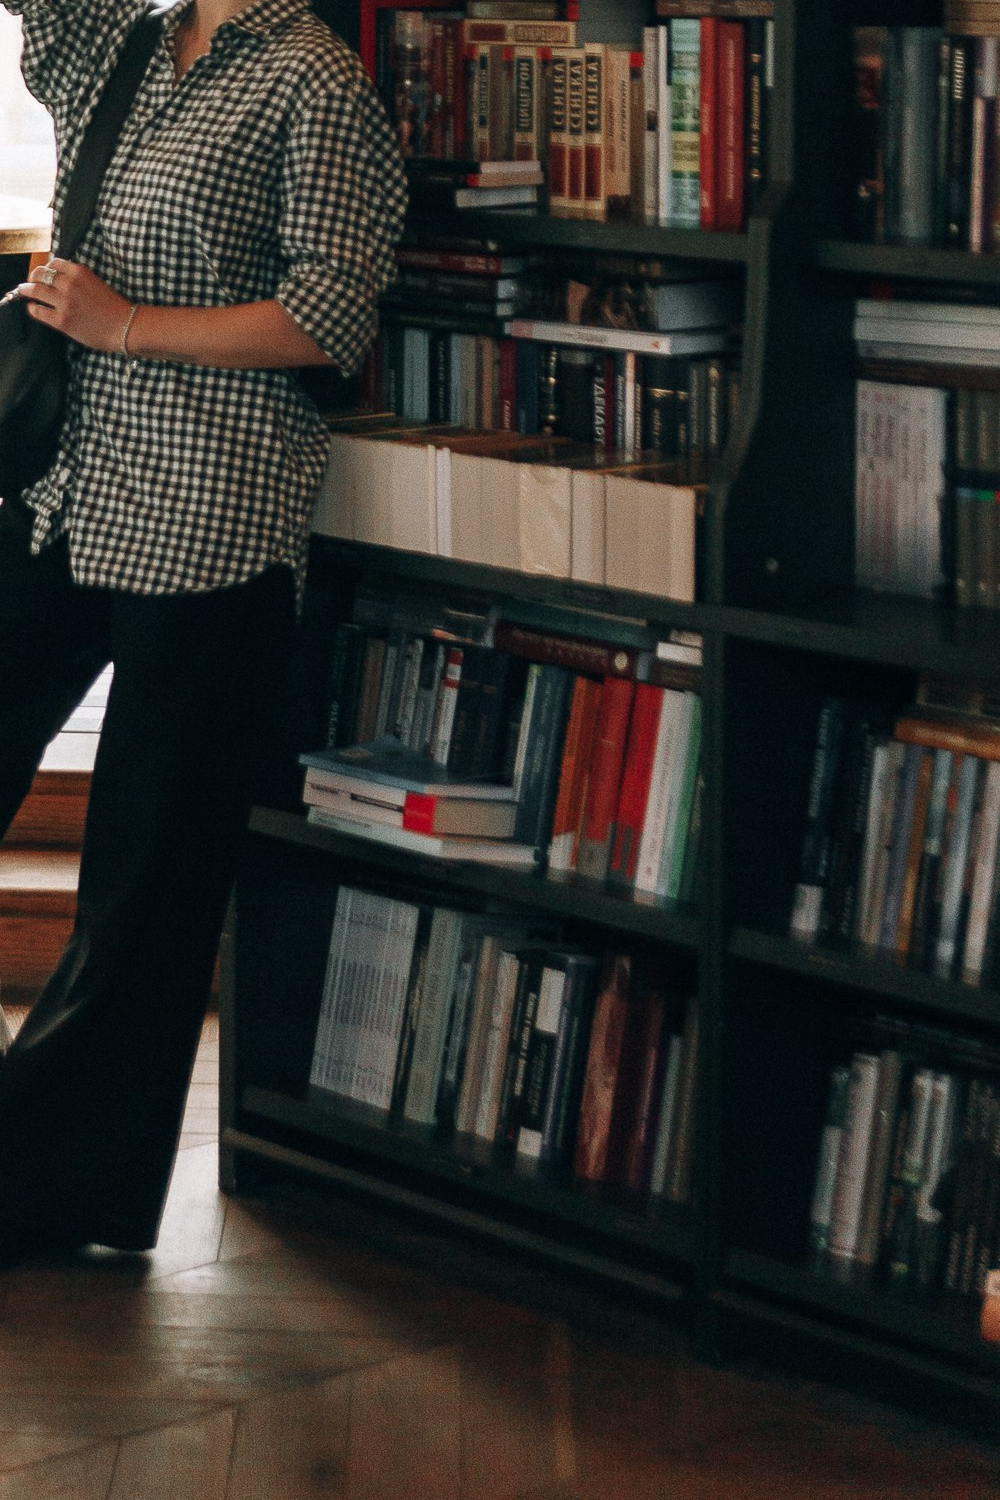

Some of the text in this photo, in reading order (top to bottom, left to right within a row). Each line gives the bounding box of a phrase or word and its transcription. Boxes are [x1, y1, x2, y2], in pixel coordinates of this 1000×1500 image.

[518, 61, 531, 128] ЦИЦЕРОН
[552, 60, 565, 128] СЕНЕКА
[569, 64, 582, 130] СЕНЕКА
[586, 60, 599, 128] СЕНЕКА
[593, 382, 606, 446] ДЕКАРТ
